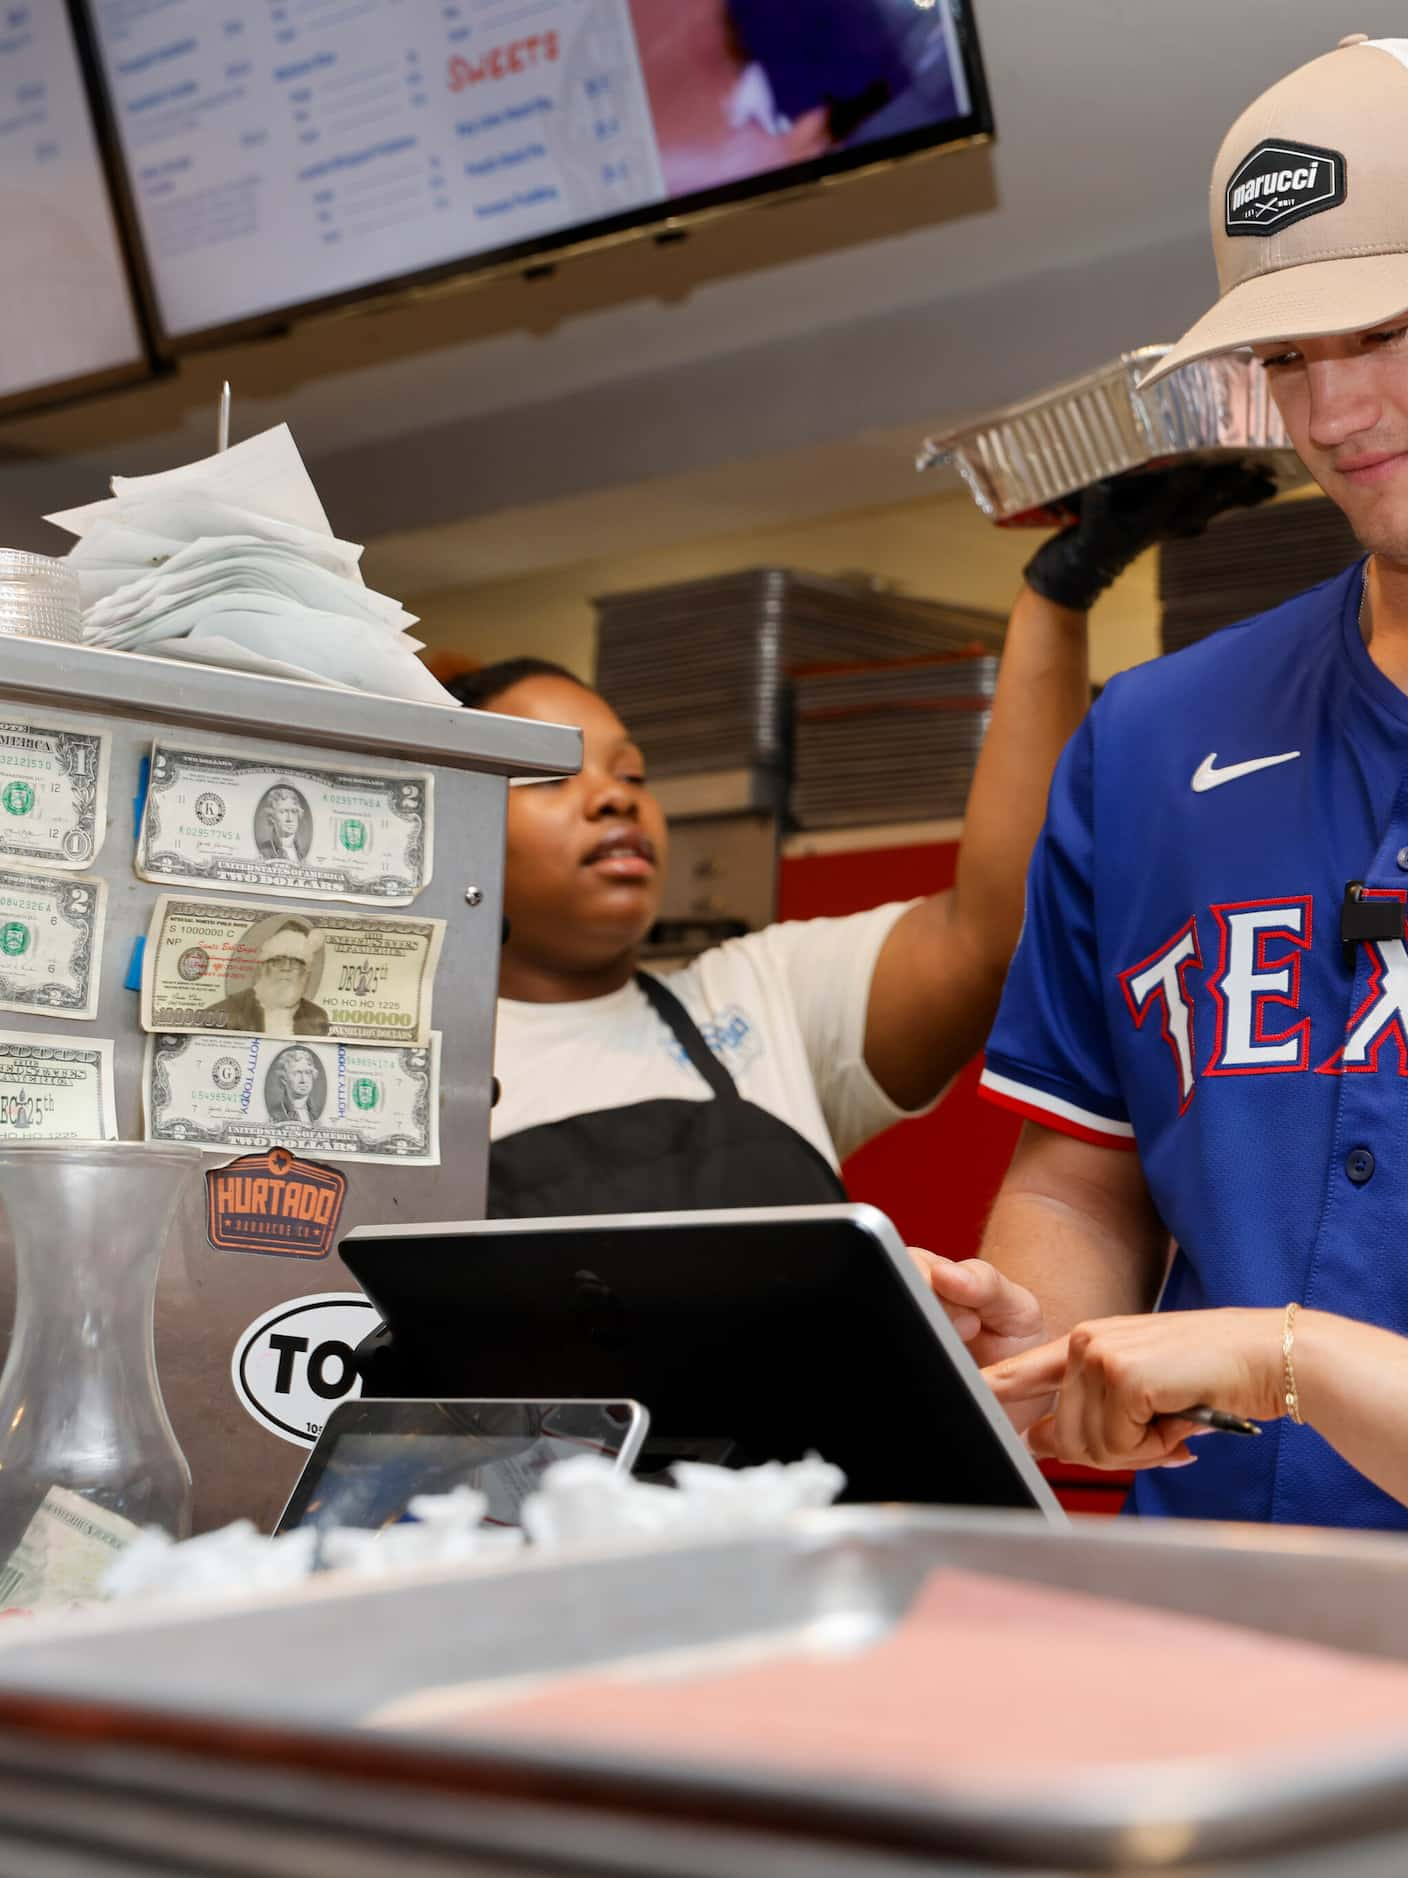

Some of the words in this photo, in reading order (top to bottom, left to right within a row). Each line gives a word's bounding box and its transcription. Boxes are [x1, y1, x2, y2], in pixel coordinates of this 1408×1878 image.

[448, 29, 558, 93] SWEETS
[1233, 162, 1319, 211] marucci
[0, 735, 51, 752] MERICA
[51, 784, 61, 793] 12
[401, 785, 419, 808] 2
[217, 871, 257, 883] TWO
[258, 875, 345, 891] DOLLARS
[0, 897, 51, 912] 0842326A
[71, 889, 89, 914] 2
[181, 926, 223, 937] 1000000
[322, 997, 338, 1005] HO
[342, 999, 357, 1007] HO
[360, 1000, 375, 1008] HO
[331, 1009, 412, 1027] 1000000
[216, 1177, 337, 1225] HURTADO
[236, 1219, 291, 1236] BARBECUE
